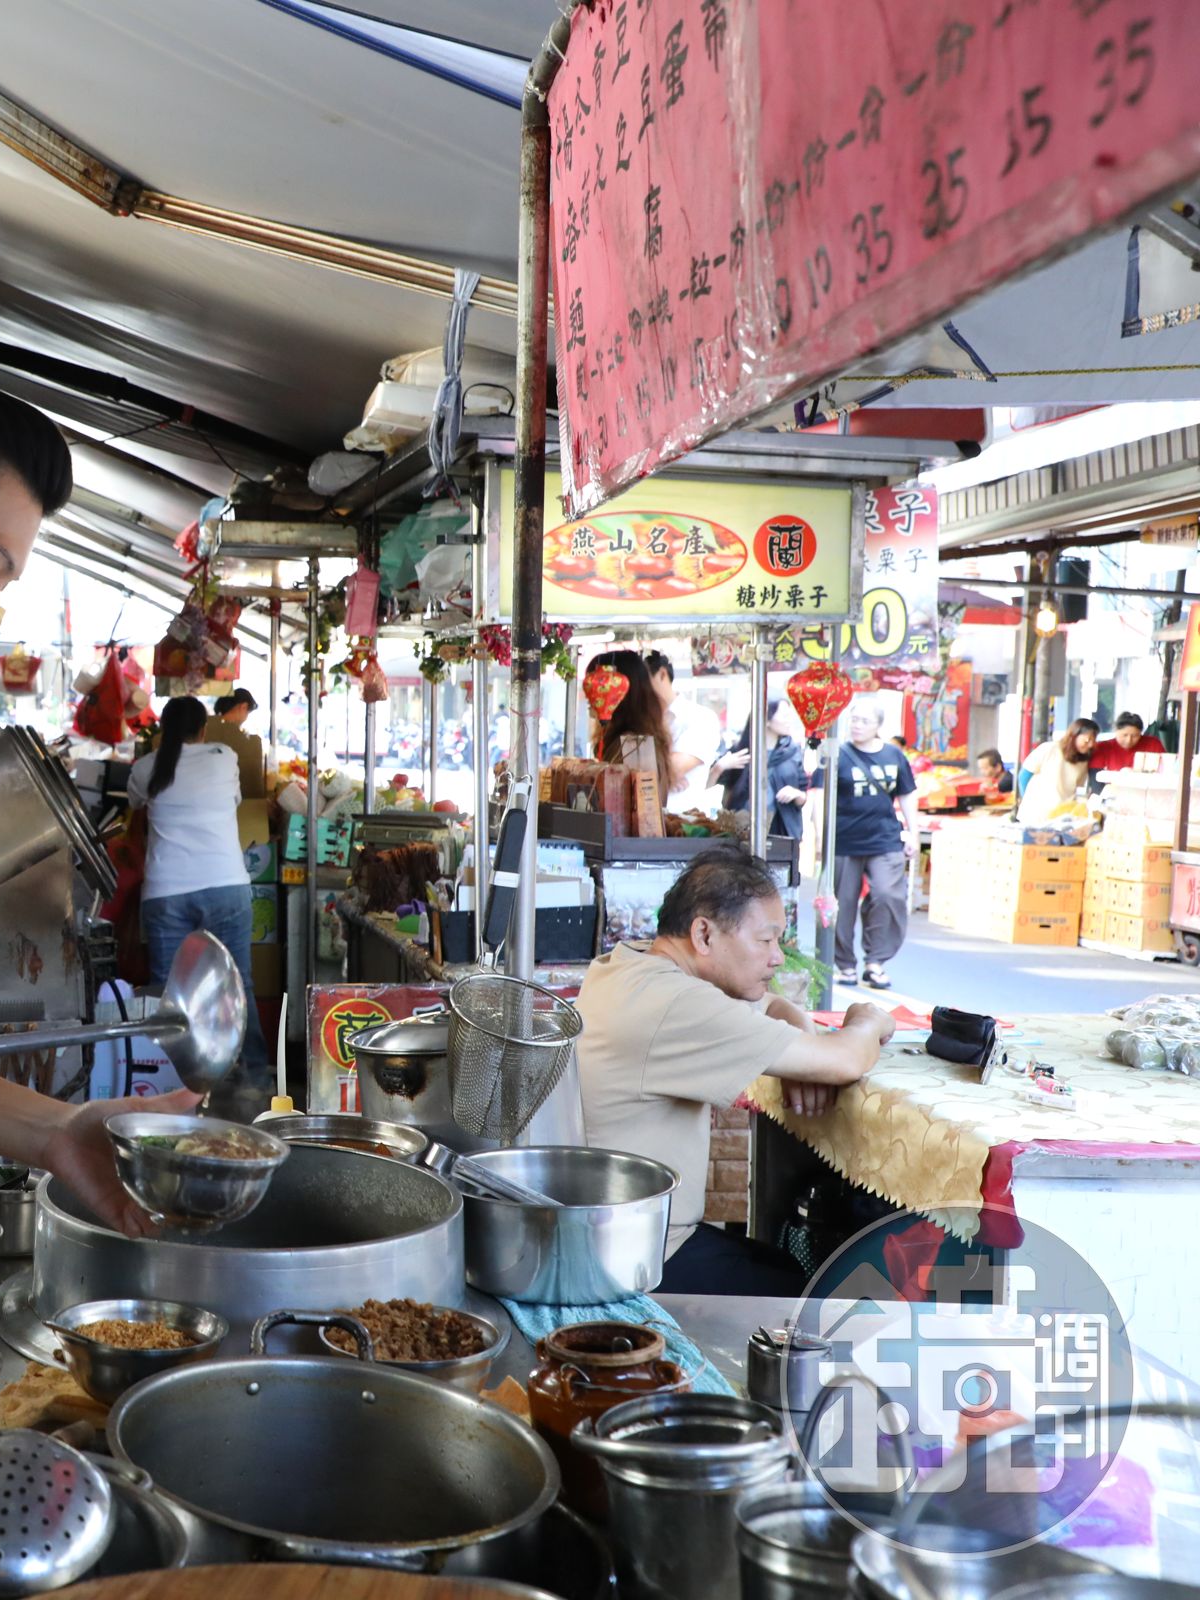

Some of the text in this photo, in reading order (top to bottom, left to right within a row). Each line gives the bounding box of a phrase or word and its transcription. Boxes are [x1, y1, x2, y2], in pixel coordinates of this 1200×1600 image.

[1090, 16, 1156, 129] 35
[851, 203, 894, 285] 35
[570, 524, 709, 557] 燕山名產
[768, 524, 804, 570] 蘭
[735, 584, 829, 610] 糖炒栗子
[908, 634, 930, 655] 元
